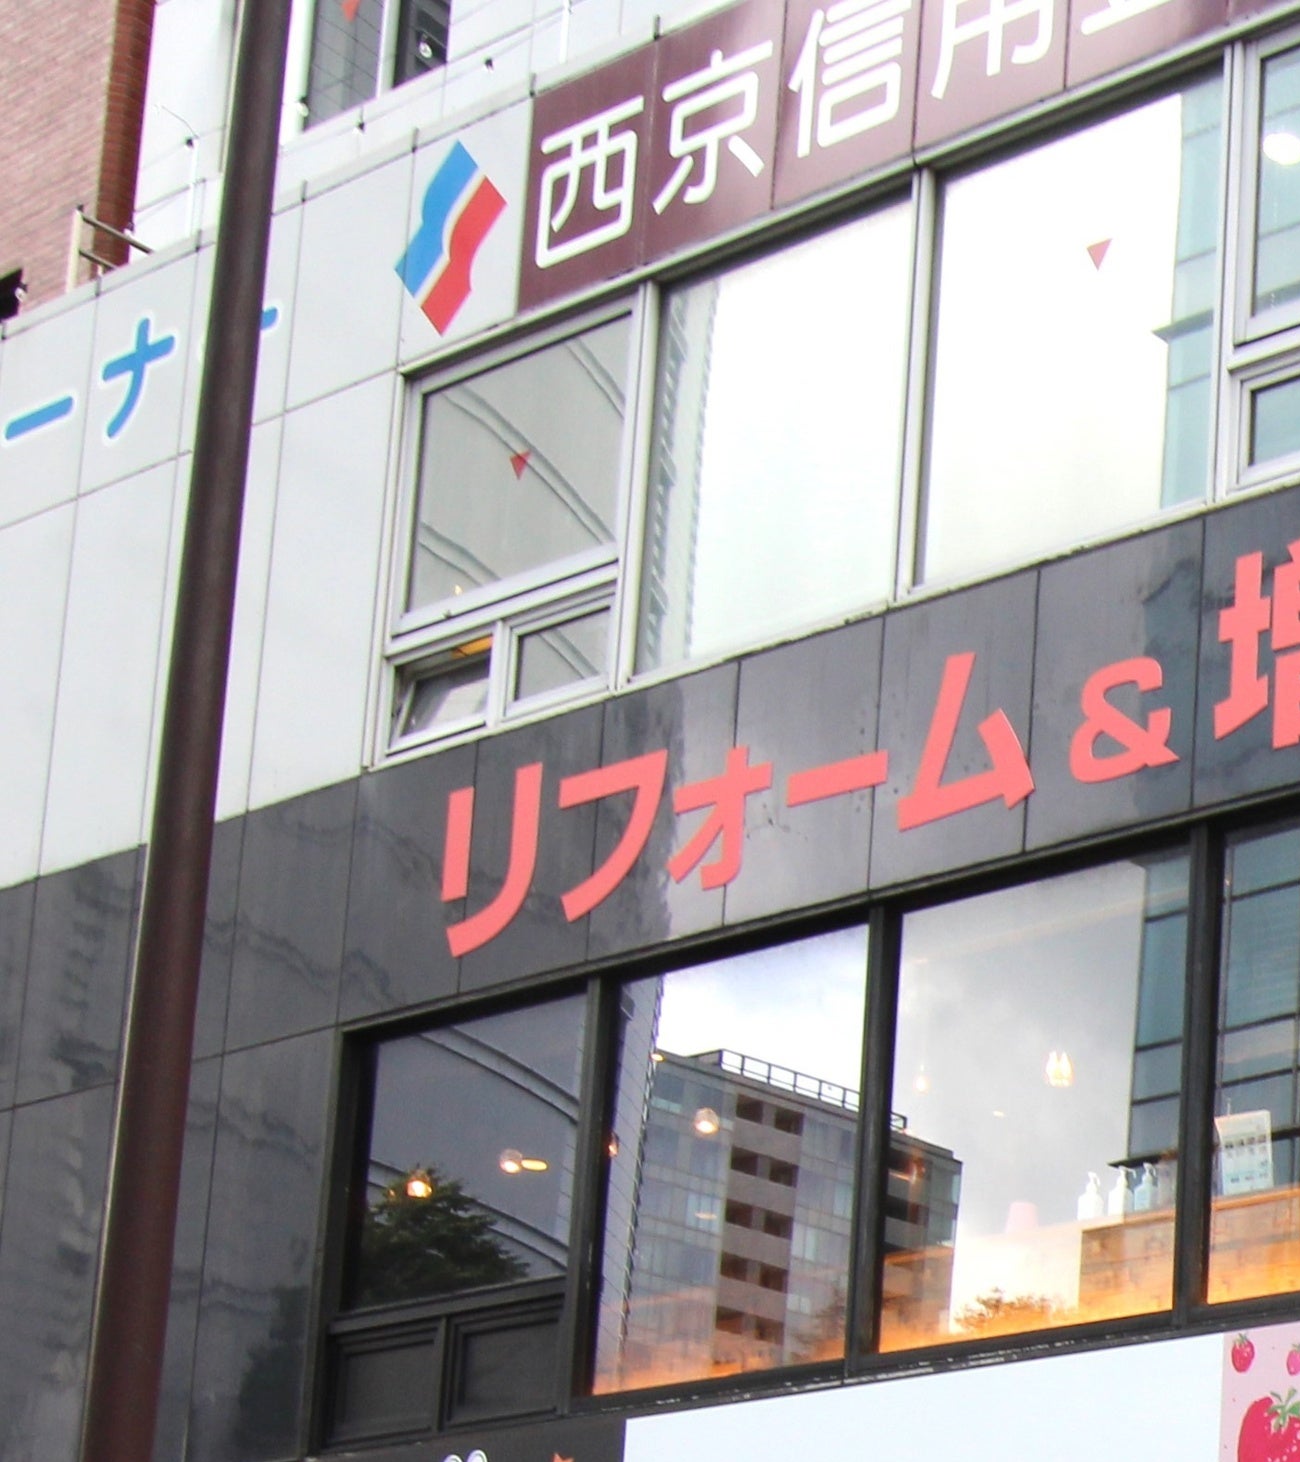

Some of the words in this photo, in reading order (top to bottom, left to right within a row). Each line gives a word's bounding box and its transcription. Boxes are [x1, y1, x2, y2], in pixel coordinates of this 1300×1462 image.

[534, 0, 1172, 269] 西京信用
[5, 306, 279, 440] ーナ
